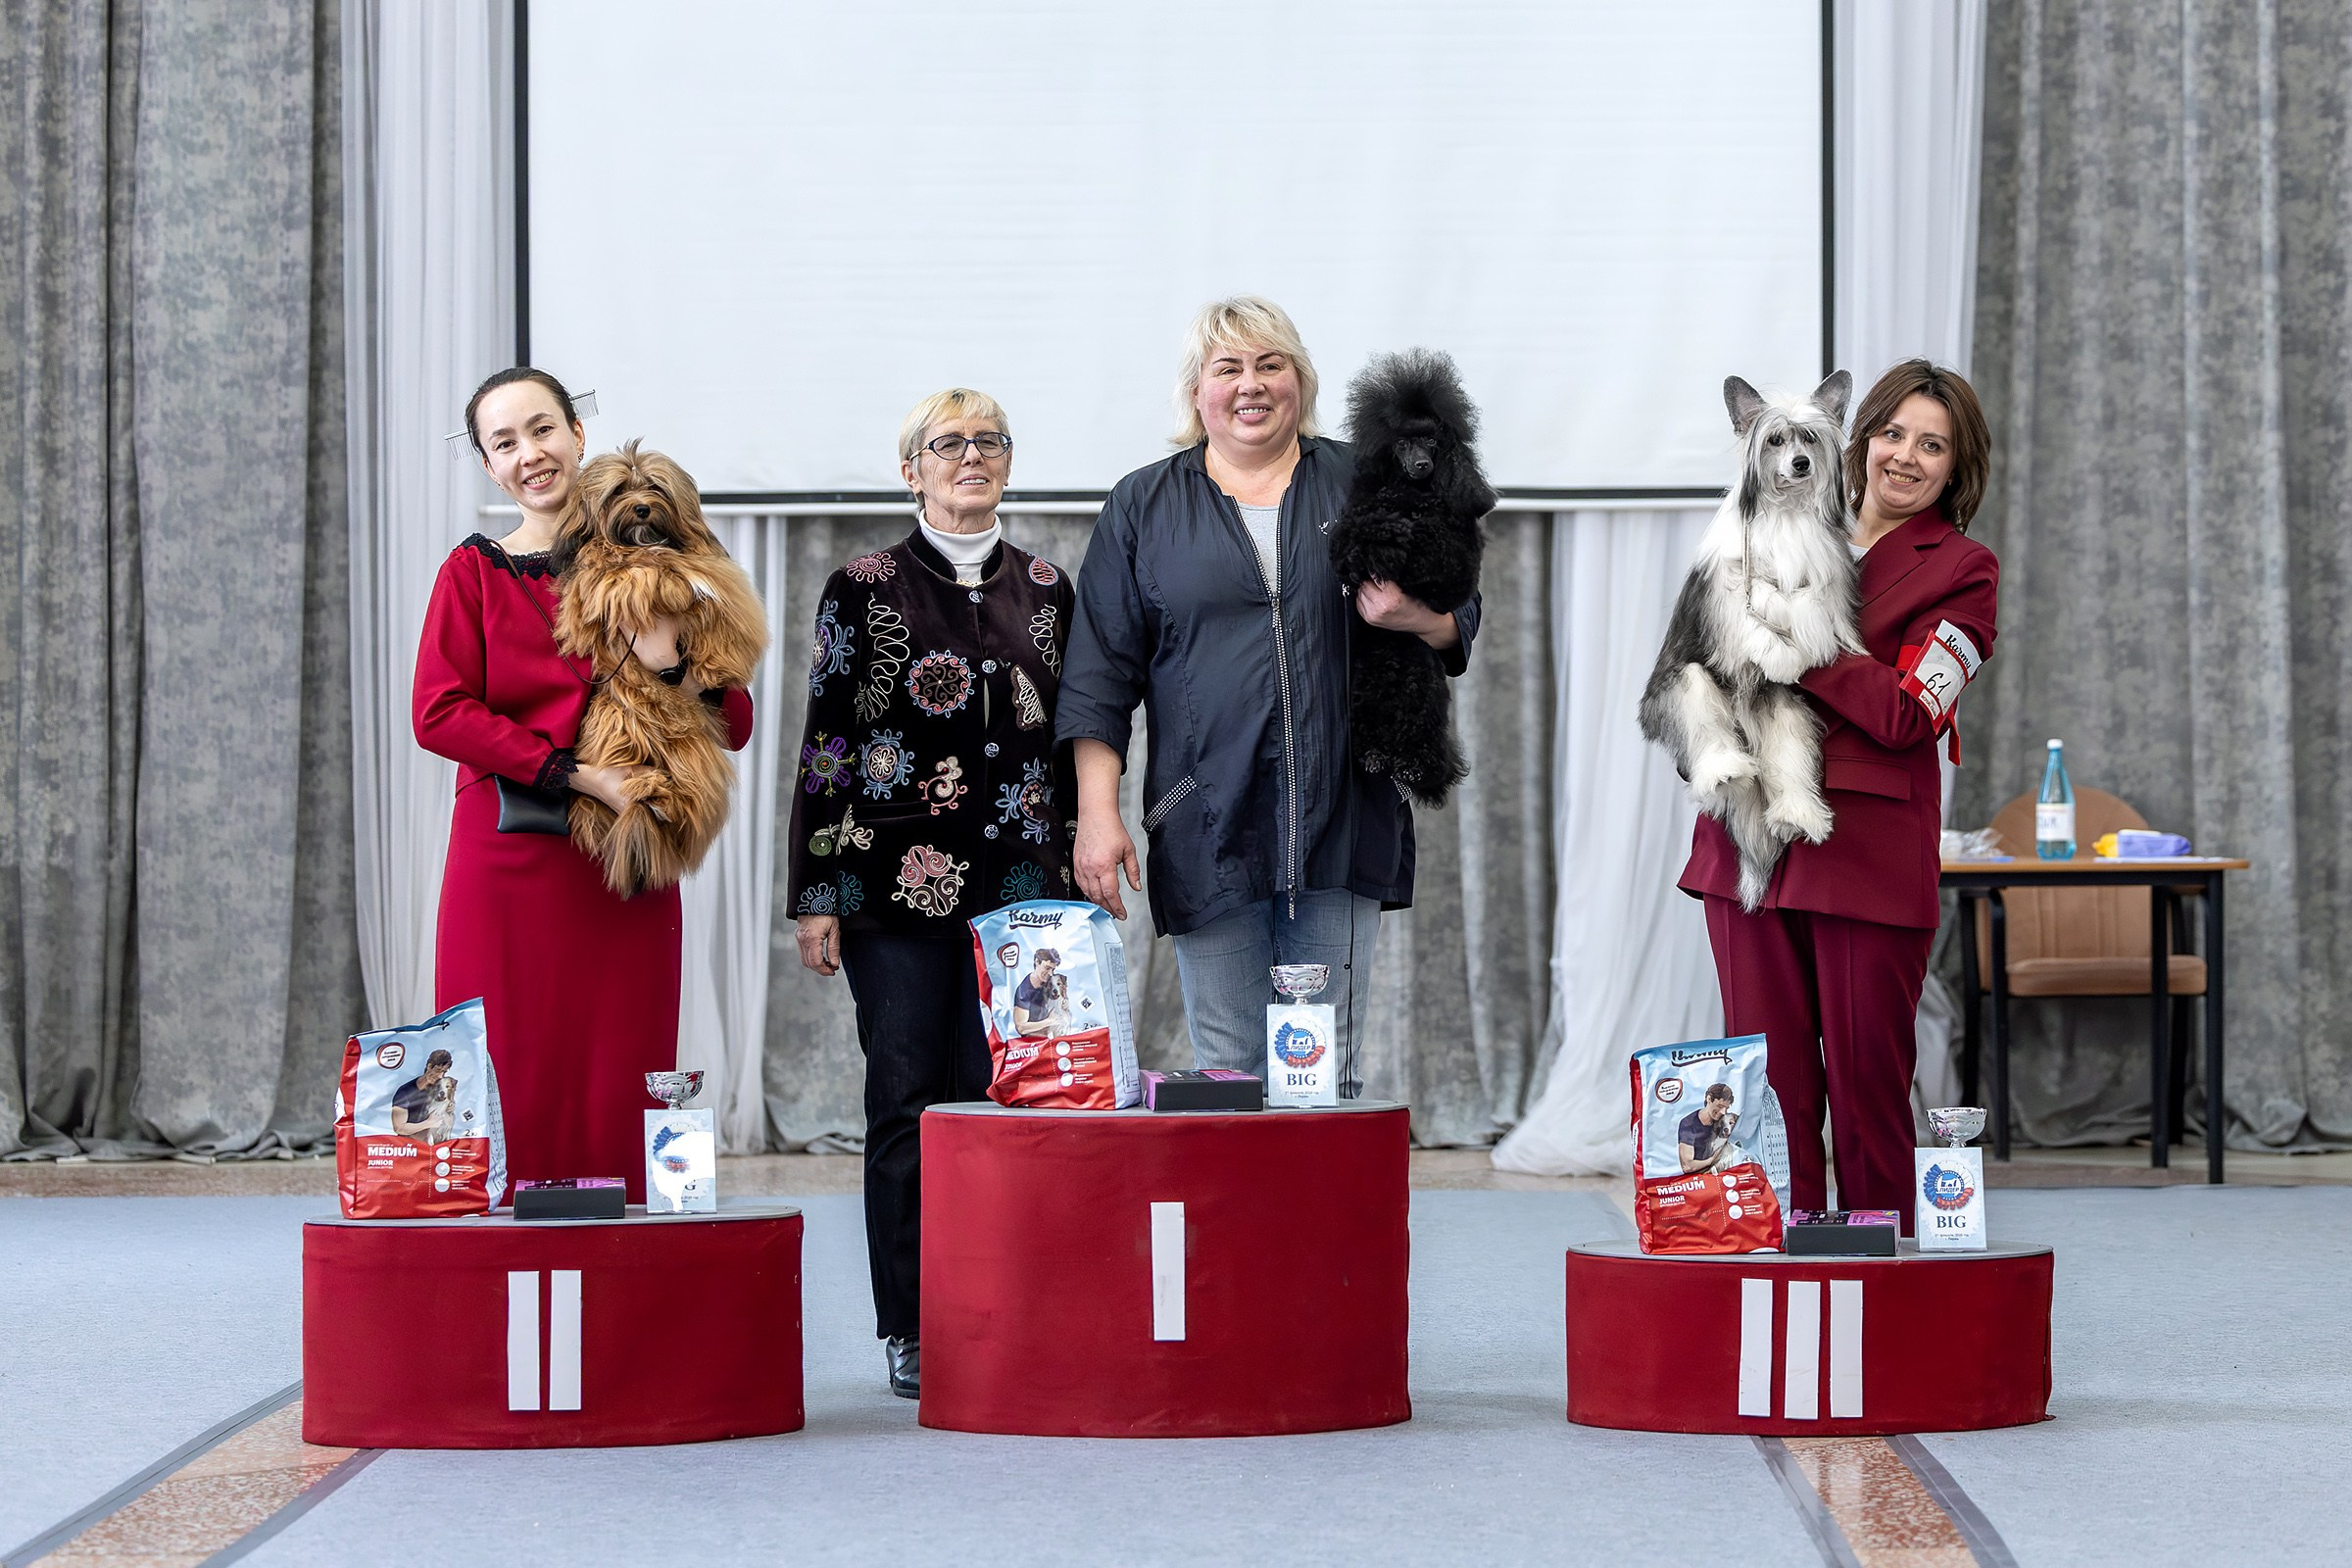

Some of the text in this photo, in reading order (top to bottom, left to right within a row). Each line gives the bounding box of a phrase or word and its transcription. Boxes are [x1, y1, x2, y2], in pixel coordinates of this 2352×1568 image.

[1944, 634, 1972, 669] Karmy
[1926, 672, 1951, 696] 61
[1008, 910, 1064, 930] Karmy
[1287, 1073, 1317, 1086] BIG
[368, 1146, 417, 1157] MEDIUM
[1657, 1179, 1705, 1196] MEDIUM
[1659, 1196, 1686, 1204] JUNIOR
[1936, 1214, 1967, 1228] BIG
